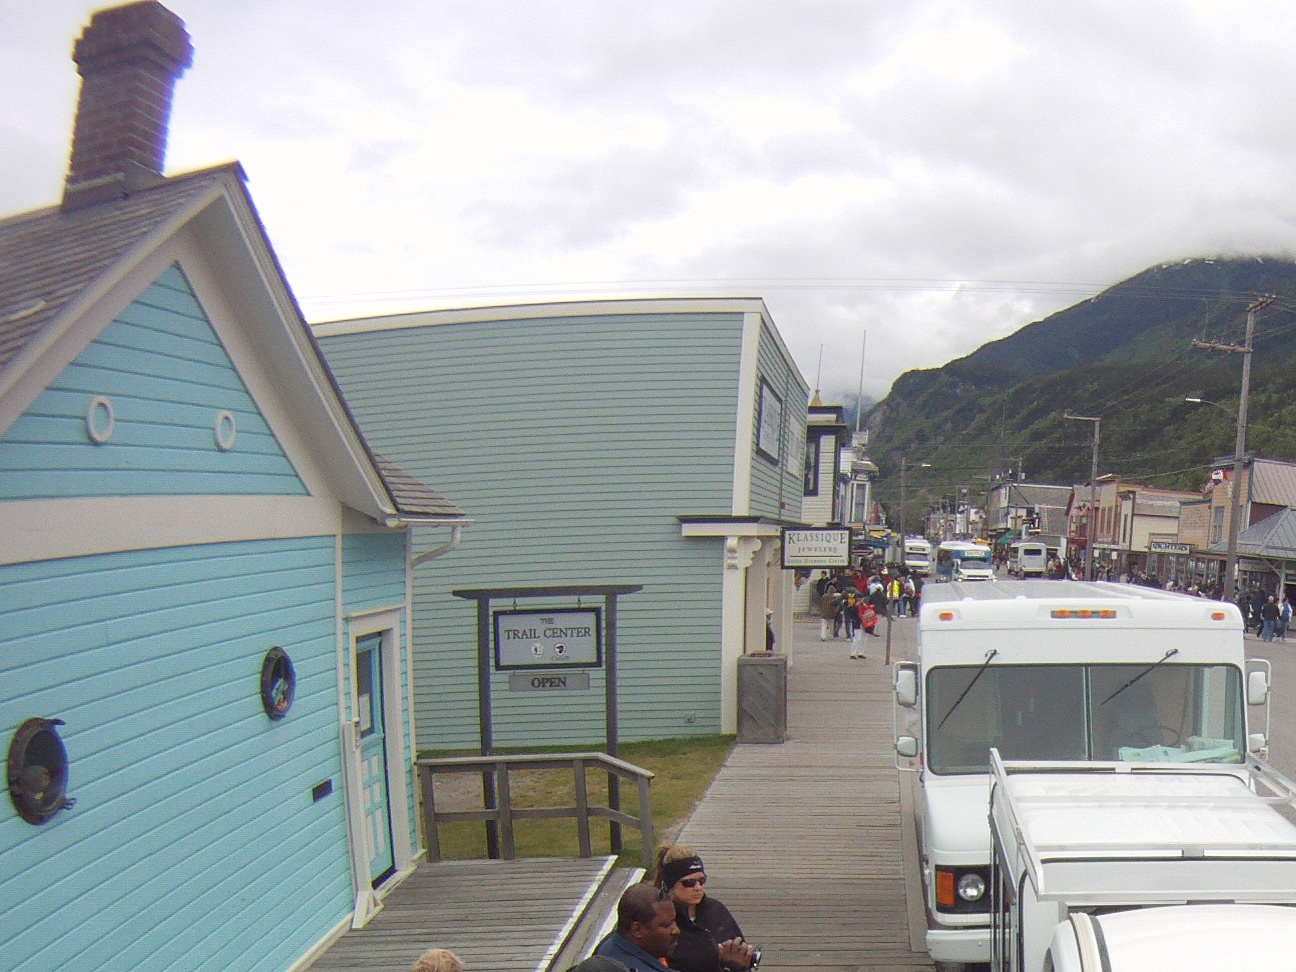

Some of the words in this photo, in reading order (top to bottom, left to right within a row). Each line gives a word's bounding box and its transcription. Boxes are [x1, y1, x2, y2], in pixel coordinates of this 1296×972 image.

[788, 532, 846, 544] KLASSIQUE
[539, 617, 555, 625] THE
[504, 628, 540, 640] TRAIL
[543, 626, 592, 638] CENTER
[531, 677, 567, 688] OPEN
